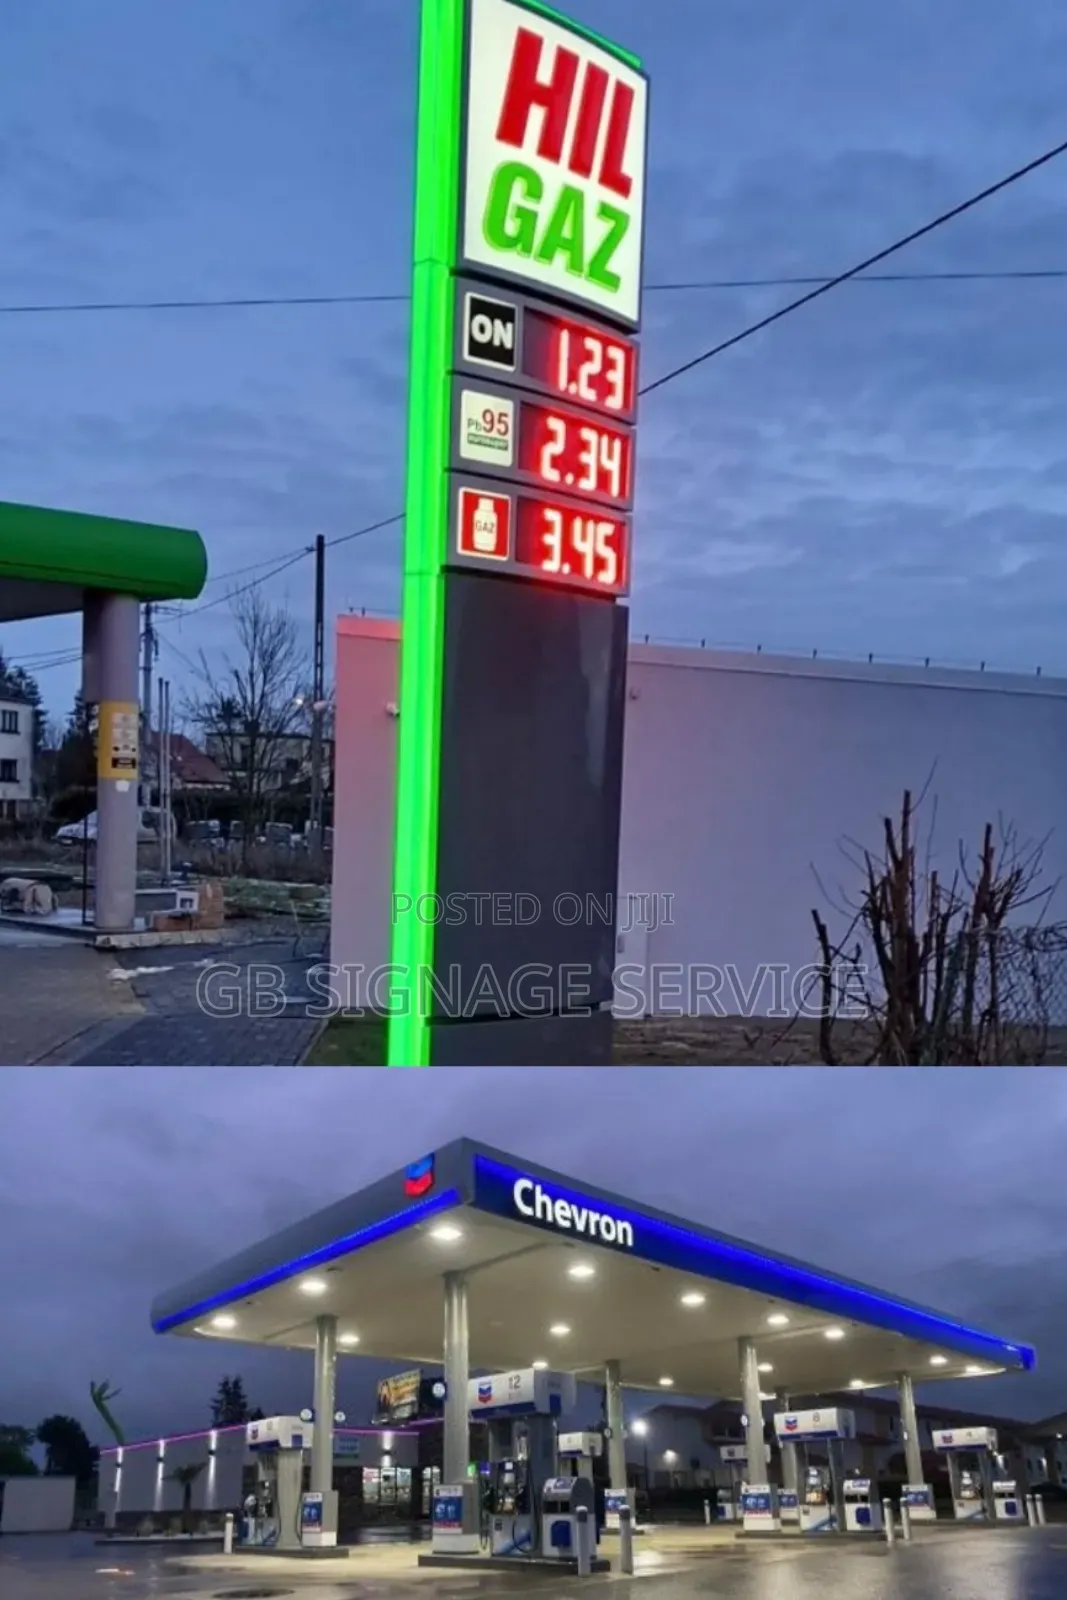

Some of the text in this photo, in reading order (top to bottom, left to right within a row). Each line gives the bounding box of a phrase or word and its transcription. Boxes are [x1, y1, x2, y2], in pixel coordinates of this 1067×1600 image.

[495, 26, 635, 200] HIL
[481, 159, 631, 294] GAZ
[471, 313, 513, 350] ON
[558, 328, 626, 411] 1.23
[541, 416, 622, 498] 2.34
[541, 507, 617, 585] 3.45
[513, 1177, 634, 1248] Chevron
